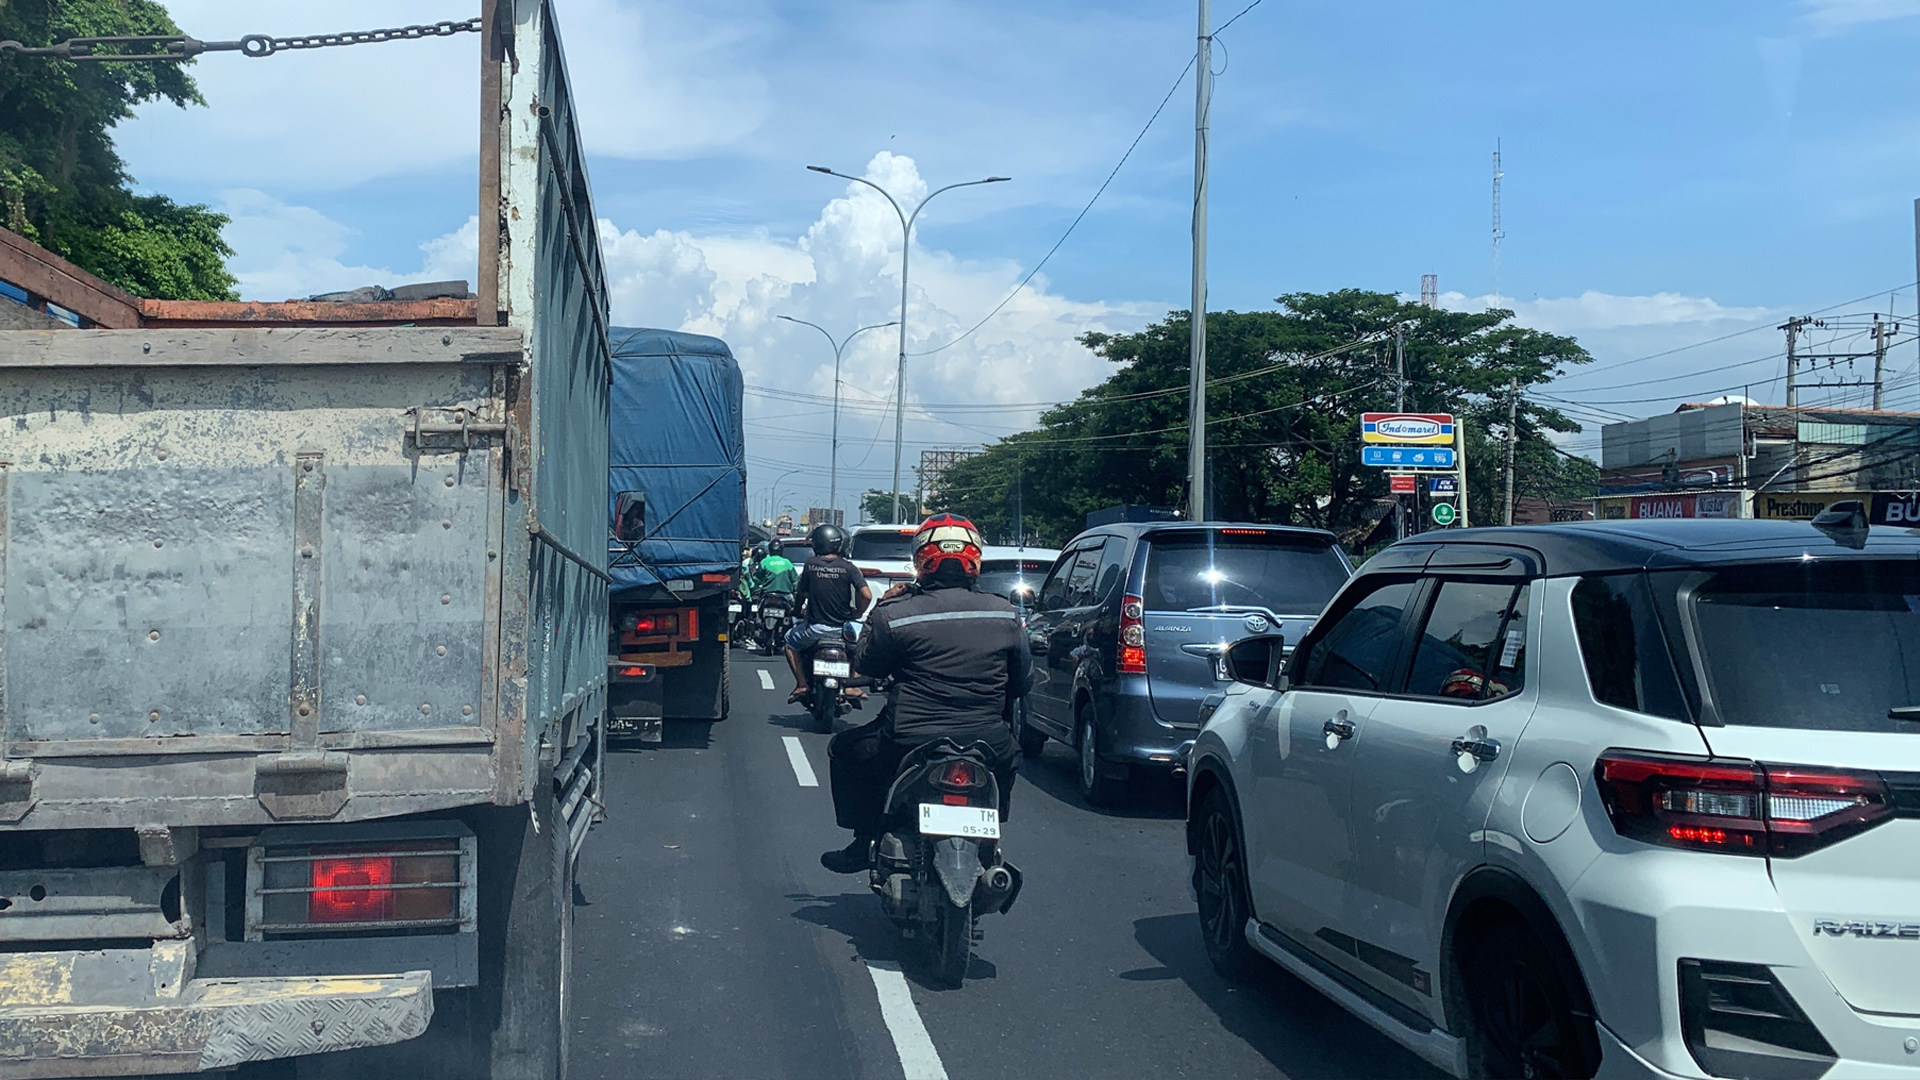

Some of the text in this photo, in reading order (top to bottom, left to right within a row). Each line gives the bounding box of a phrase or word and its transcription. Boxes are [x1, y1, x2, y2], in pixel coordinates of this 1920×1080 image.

[1380, 423, 1436, 434] Indomaret
[1639, 501, 1683, 519] BUANA
[816, 571, 839, 579] UNITED
[980, 810, 995, 822] TM
[1813, 918, 1920, 940] RAIZE
